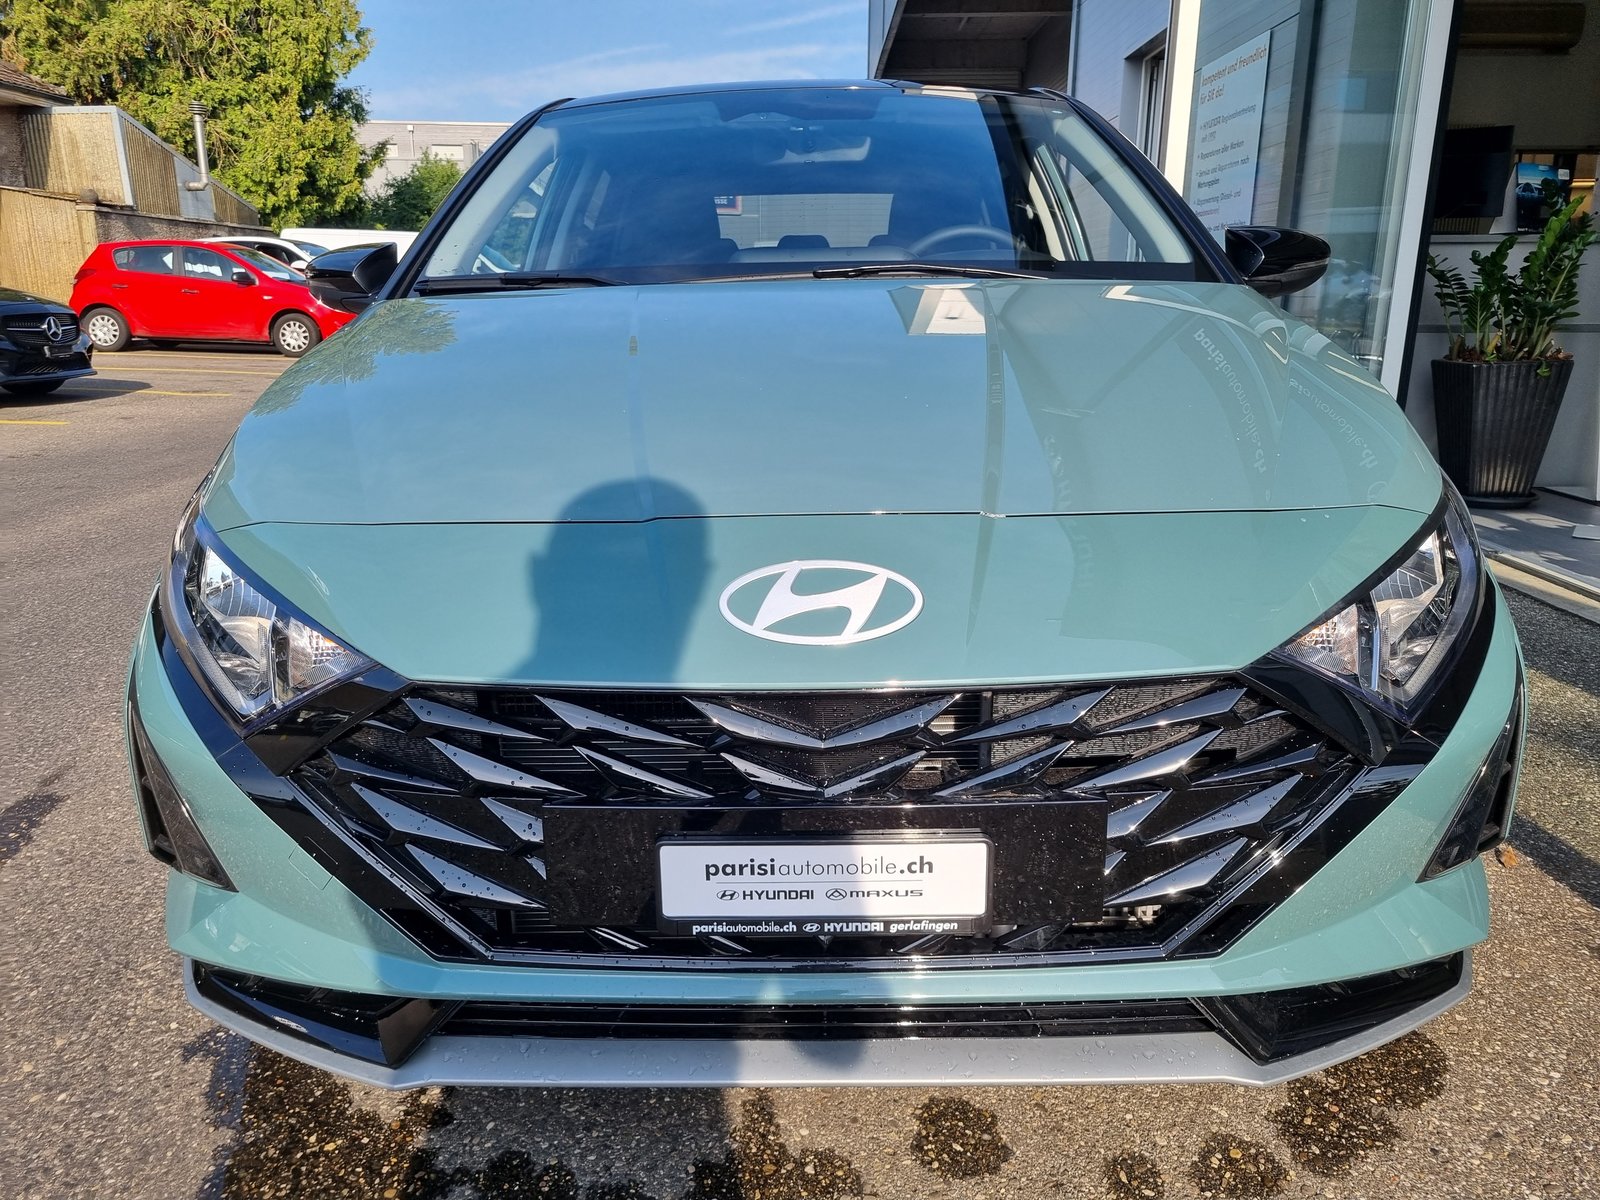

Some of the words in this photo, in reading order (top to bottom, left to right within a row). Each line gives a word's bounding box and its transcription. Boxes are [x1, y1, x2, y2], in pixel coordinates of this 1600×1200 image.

[1201, 65, 1227, 87] kompetent
[1227, 57, 1238, 75] und
[1238, 44, 1268, 69] freundlich
[705, 856, 934, 881] parisiautomobile.ch
[742, 889, 814, 900] HYUNDAI
[850, 889, 923, 897] MAXUS
[692, 921, 797, 935] parisiautomobile.ch
[824, 922, 884, 932] HYUNDAI
[889, 920, 958, 933] gerlafingen
